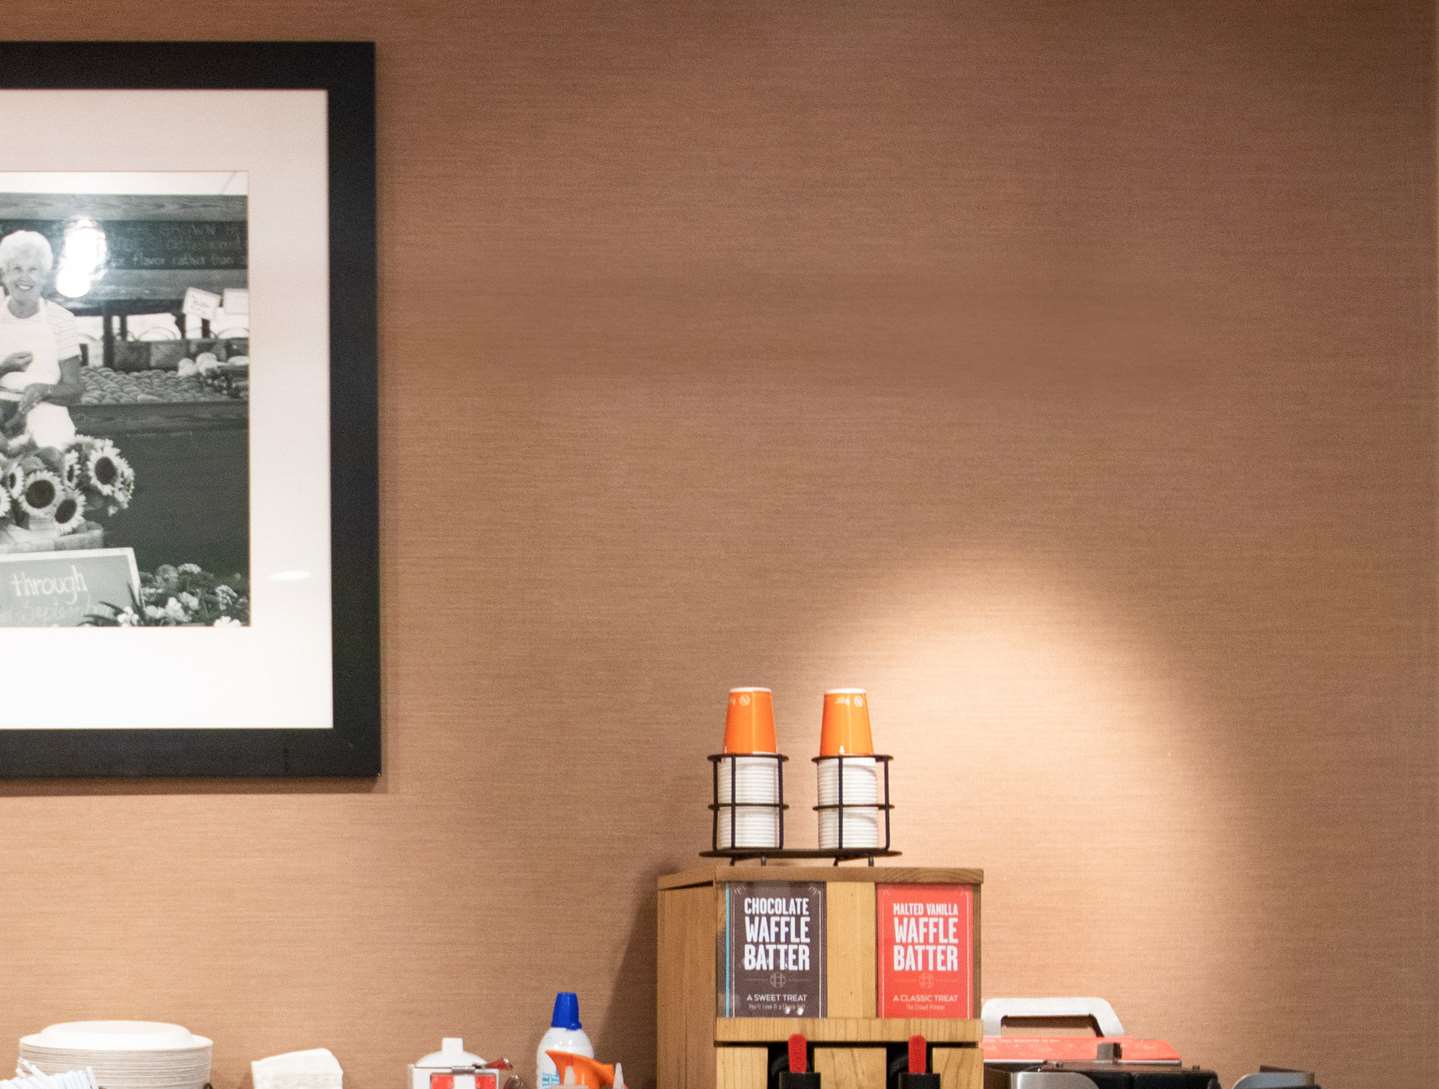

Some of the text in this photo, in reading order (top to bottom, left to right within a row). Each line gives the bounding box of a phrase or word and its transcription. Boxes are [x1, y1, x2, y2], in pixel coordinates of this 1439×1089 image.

[11, 564, 88, 604] through
[744, 897, 810, 915] CHOCOLATE
[892, 903, 959, 916] MALTED VANILLA
[745, 916, 811, 943] WAFFLE
[893, 916, 959, 944] WAFFLE
[744, 944, 810, 971] BATTER
[893, 945, 959, 972] BATTER
[754, 993, 780, 1001] SWEET
[782, 993, 808, 1001] TREAT
